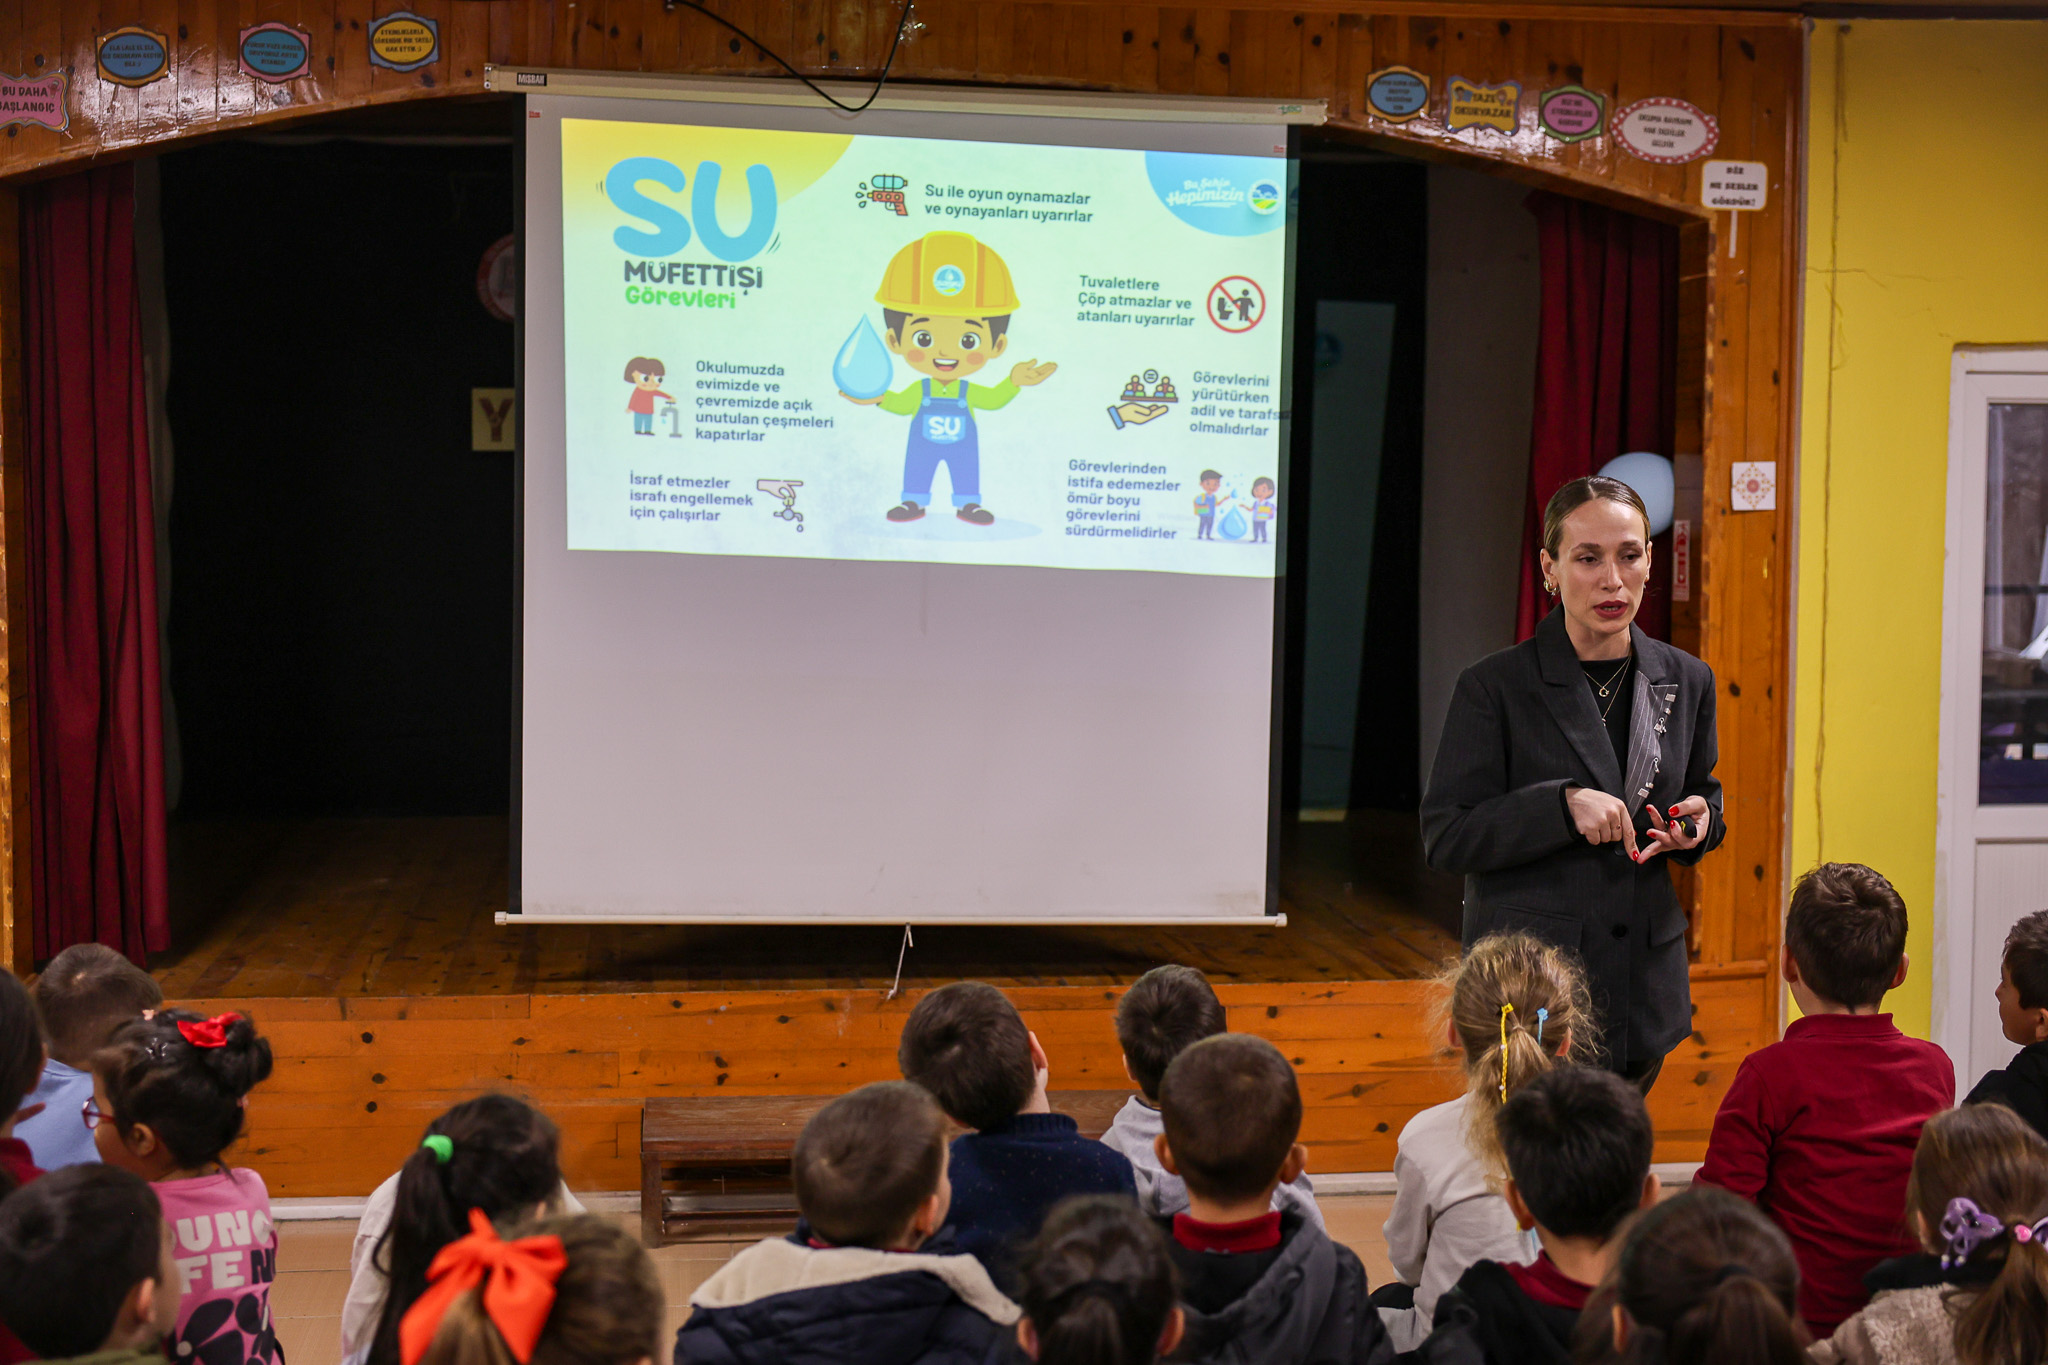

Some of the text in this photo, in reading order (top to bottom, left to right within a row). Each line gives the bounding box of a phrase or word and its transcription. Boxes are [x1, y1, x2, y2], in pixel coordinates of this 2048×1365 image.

[2, 86, 48, 97] BU DAHA
[925, 184, 1090, 207] Su ile oyun oynamazlar
[605, 156, 778, 262] SU
[925, 204, 1094, 224] ve oynayanları uyarırlar
[624, 260, 763, 296] MÜFETTİŞİ
[1080, 275, 1160, 291] Tuvaletlere
[625, 285, 736, 309] Görevleri
[1078, 292, 1192, 310] Çöp atmazlar ve
[1077, 310, 1195, 328] atanları uyarırlar
[695, 360, 785, 377] Okulumuzda
[696, 378, 780, 392] evimizde ve
[1193, 371, 1269, 387] Görevlerini
[695, 395, 813, 413] çevremizde açık
[1192, 388, 1270, 404] yürütürken
[1190, 404, 1216, 418] adil
[1219, 407, 1235, 418] ve
[478, 398, 514, 443] Y
[695, 412, 834, 430] unutulan çeşmeleri
[928, 416, 961, 436] SU
[1190, 421, 1269, 437] olmalıdırlar
[695, 427, 766, 443] kapatırlar
[1068, 458, 1167, 475] Görevlerinden
[630, 470, 730, 489] İsraf etmezler
[1067, 475, 1181, 492] istifa edemezler
[630, 489, 754, 507] israfı engellemek
[1067, 492, 1140, 509] ömür boyu
[630, 506, 721, 523] için çalışırlar
[1066, 509, 1141, 523] görevlerini
[1065, 524, 1178, 540] sürdürmelidirler
